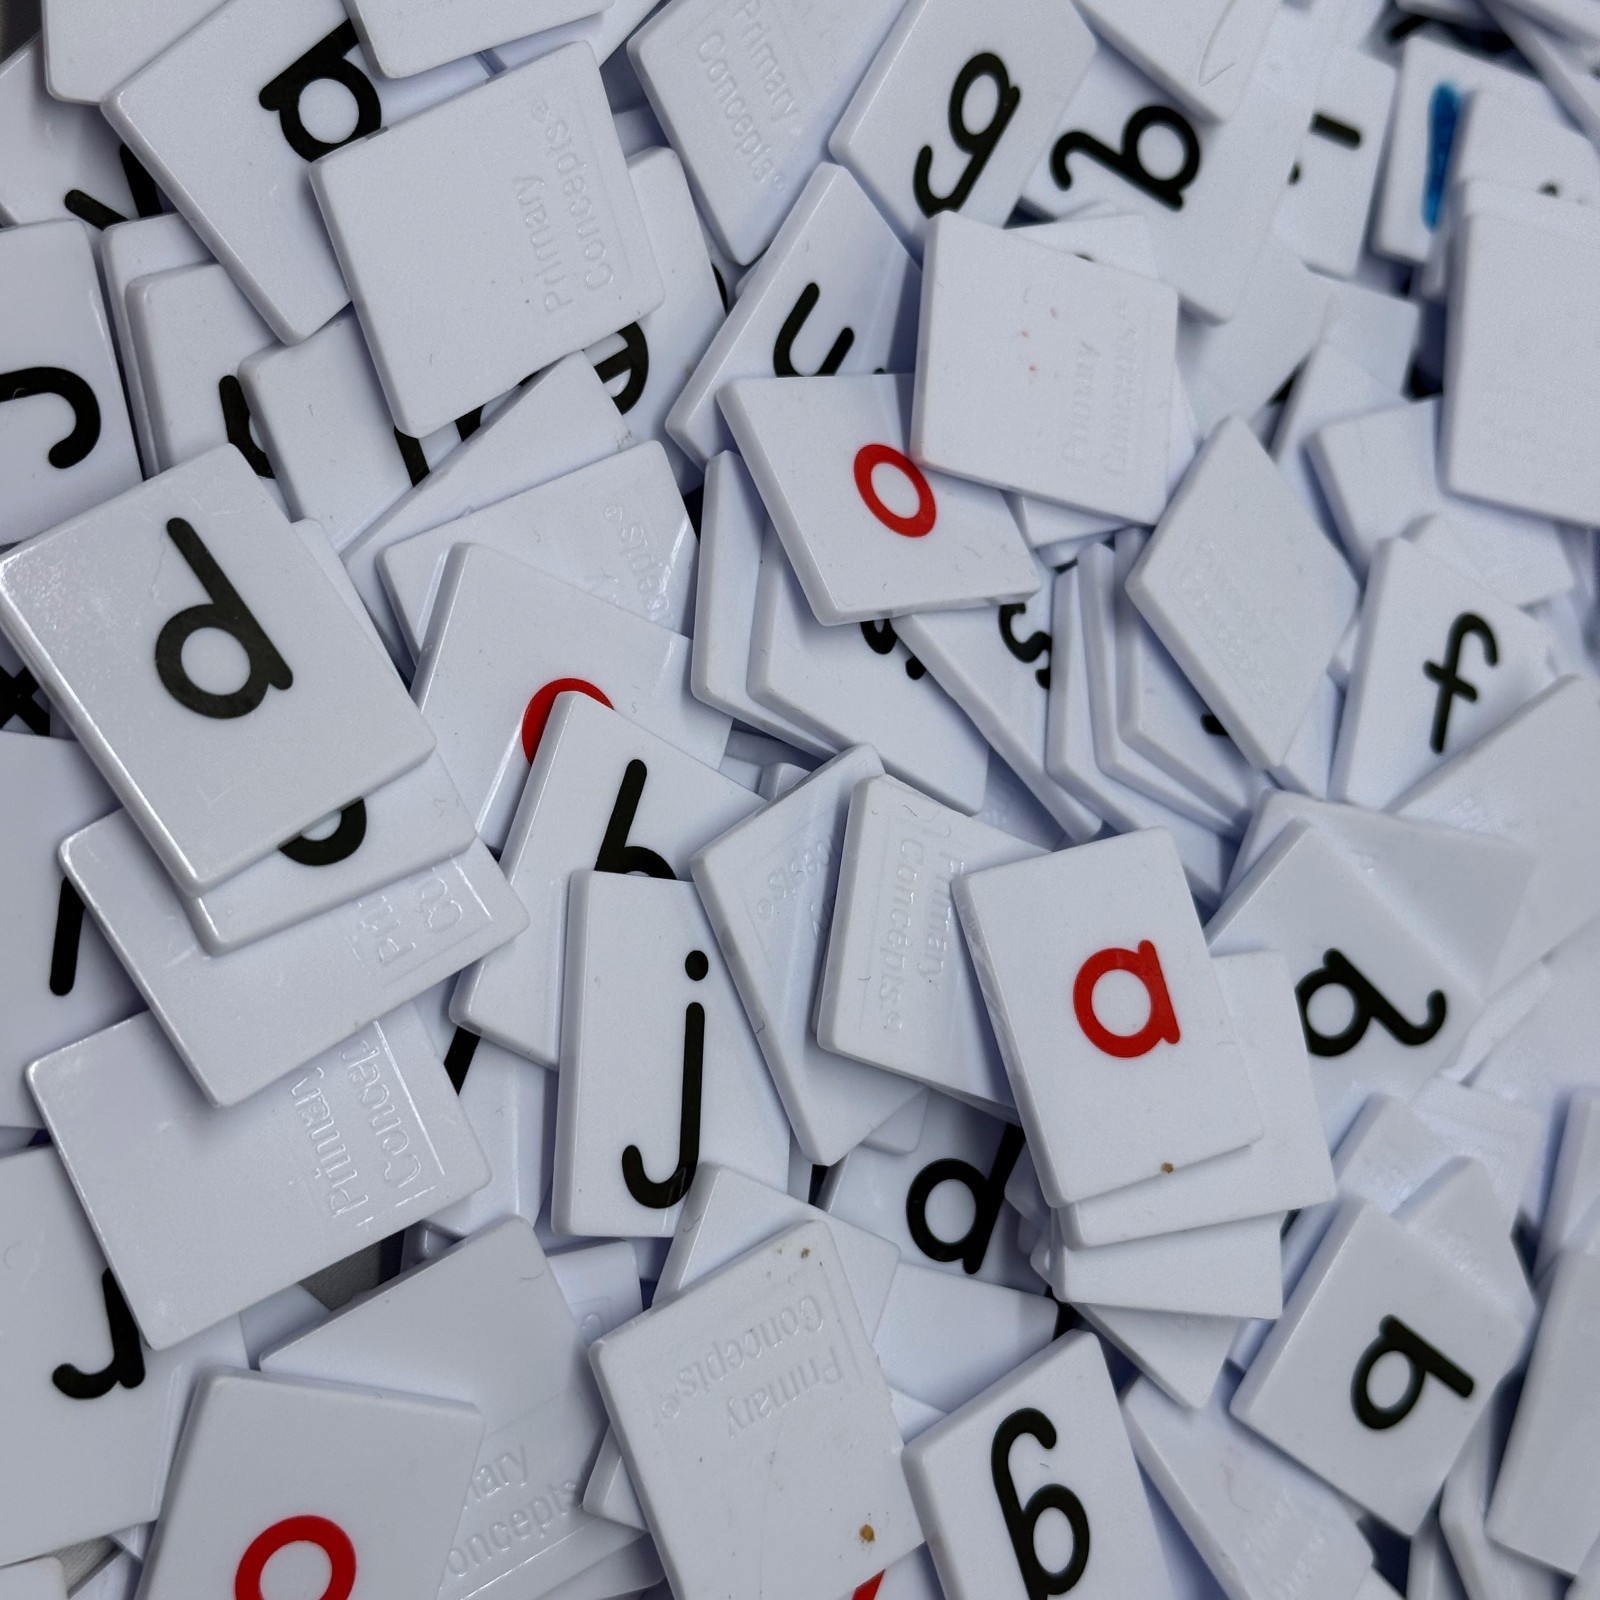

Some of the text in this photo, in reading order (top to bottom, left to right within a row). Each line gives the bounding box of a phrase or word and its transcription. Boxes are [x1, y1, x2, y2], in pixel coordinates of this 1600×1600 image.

[913, 52, 1020, 219] g
[511, 178, 574, 313] Primary
[854, 444, 936, 537] o
[154, 518, 293, 719] d
[1425, 613, 1498, 754] f
[1074, 941, 1180, 1058] a
[286, 1071, 368, 1217] Primary
[622, 950, 708, 1209] j
[906, 1122, 1025, 1275] d
[728, 1346, 845, 1438] Primary
